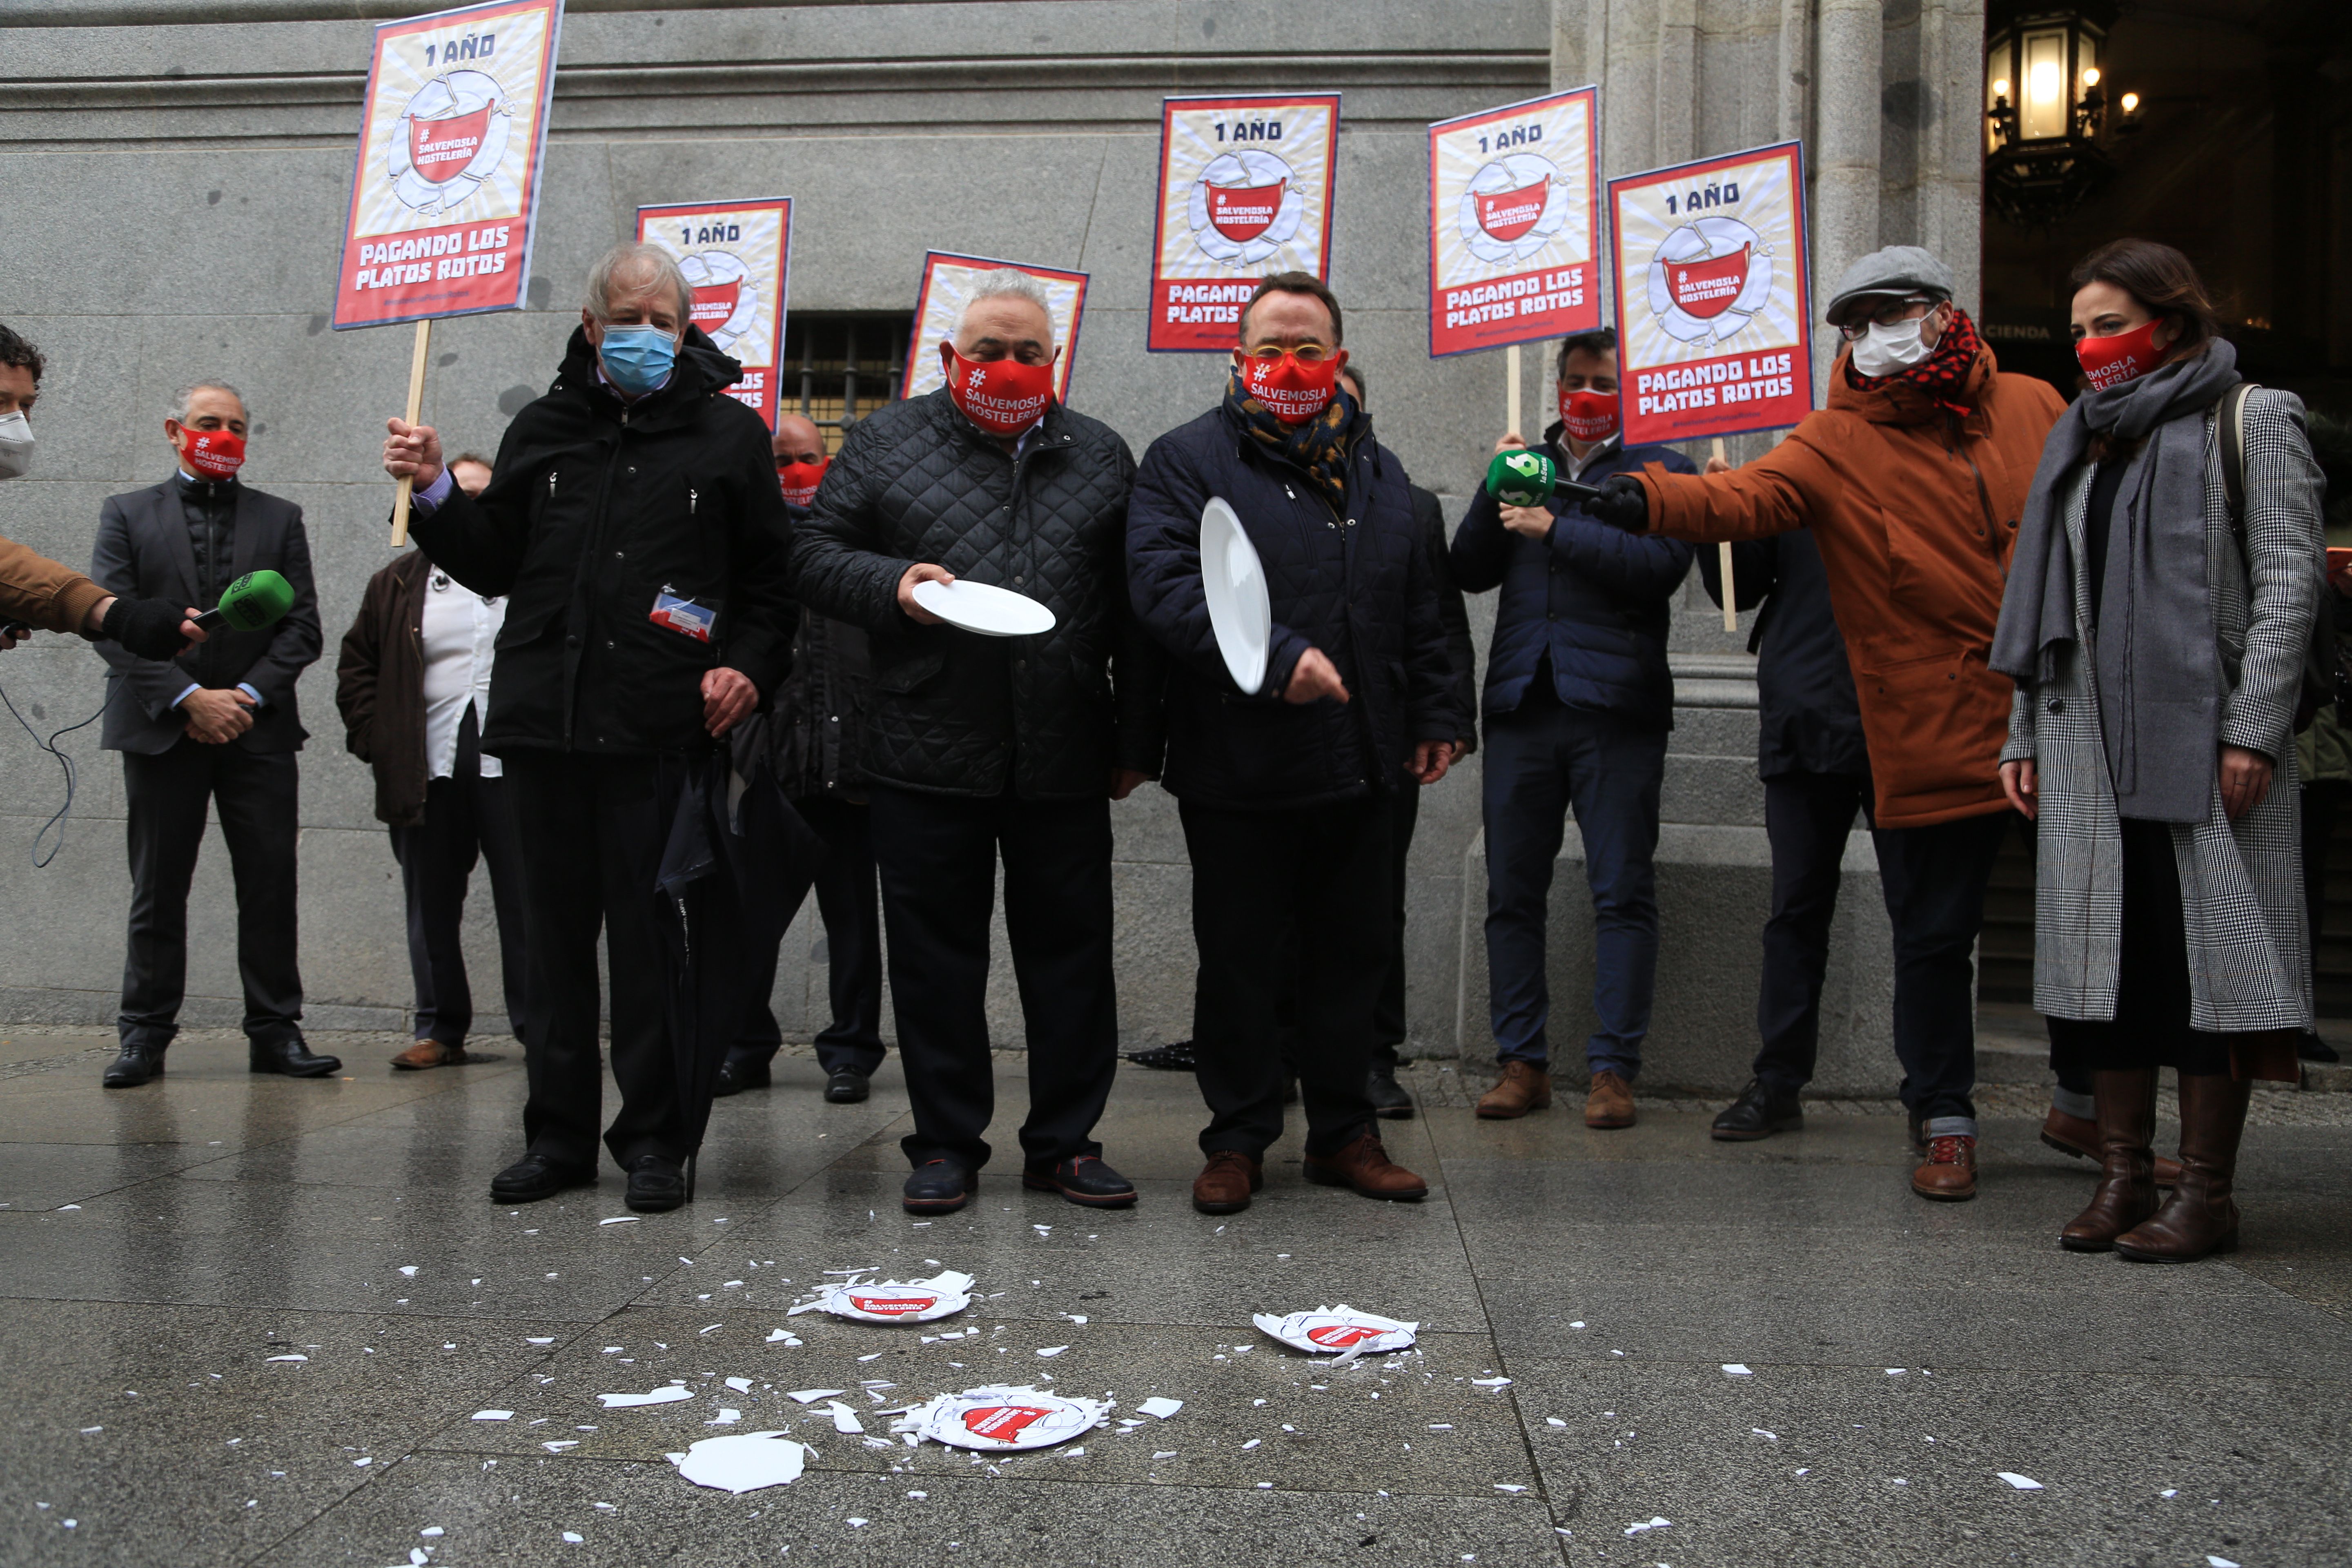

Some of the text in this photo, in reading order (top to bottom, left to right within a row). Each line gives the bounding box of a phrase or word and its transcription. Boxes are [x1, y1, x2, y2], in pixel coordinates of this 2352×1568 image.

[425, 32, 496, 67] 1 AÑO
[420, 129, 430, 143] #
[1215, 118, 1282, 141] 1 AÑO
[1479, 124, 1543, 153] 1 AÑO
[418, 136, 478, 154] SALVEMOSLA
[417, 147, 473, 165] HOSTELERÍA
[1216, 194, 1227, 206] #
[1486, 200, 1494, 212] #
[1666, 182, 1740, 215] 1 AÑO
[1216, 206, 1273, 216] SALVEMOSLA
[1216, 214, 1270, 225] HOSTELERÍA
[1486, 202, 1541, 221] SALVEMOSLA
[1486, 212, 1538, 230] HOSTELERÍA
[682, 223, 740, 244] 1 AÑO
[359, 225, 510, 267] PAGANDO LOS
[355, 252, 507, 291] PLATOS ROTOS
[1678, 271, 1688, 285] #
[1446, 268, 1584, 310] PAGANDO LOS
[1679, 275, 1740, 294] SALVEMOSLA
[1679, 286, 1738, 305] HOSTELERÍA
[1167, 306, 1239, 323] PLATOS
[1446, 289, 1584, 329] PLATOS ROTOS
[1984, 324, 2051, 340] CIENDA
[969, 368, 986, 388] #
[1253, 363, 1271, 382] #
[1638, 354, 1792, 395] PAGANDO LOS
[965, 388, 1046, 410] SALVEMOSLA
[1251, 383, 1327, 401] SALVEMOSLA
[1638, 376, 1793, 416] PLATOS ROTOS
[1562, 412, 1613, 425] SALVEMOSLA
[196, 437, 210, 449] #
[1539, 457, 1548, 484] laSexta
